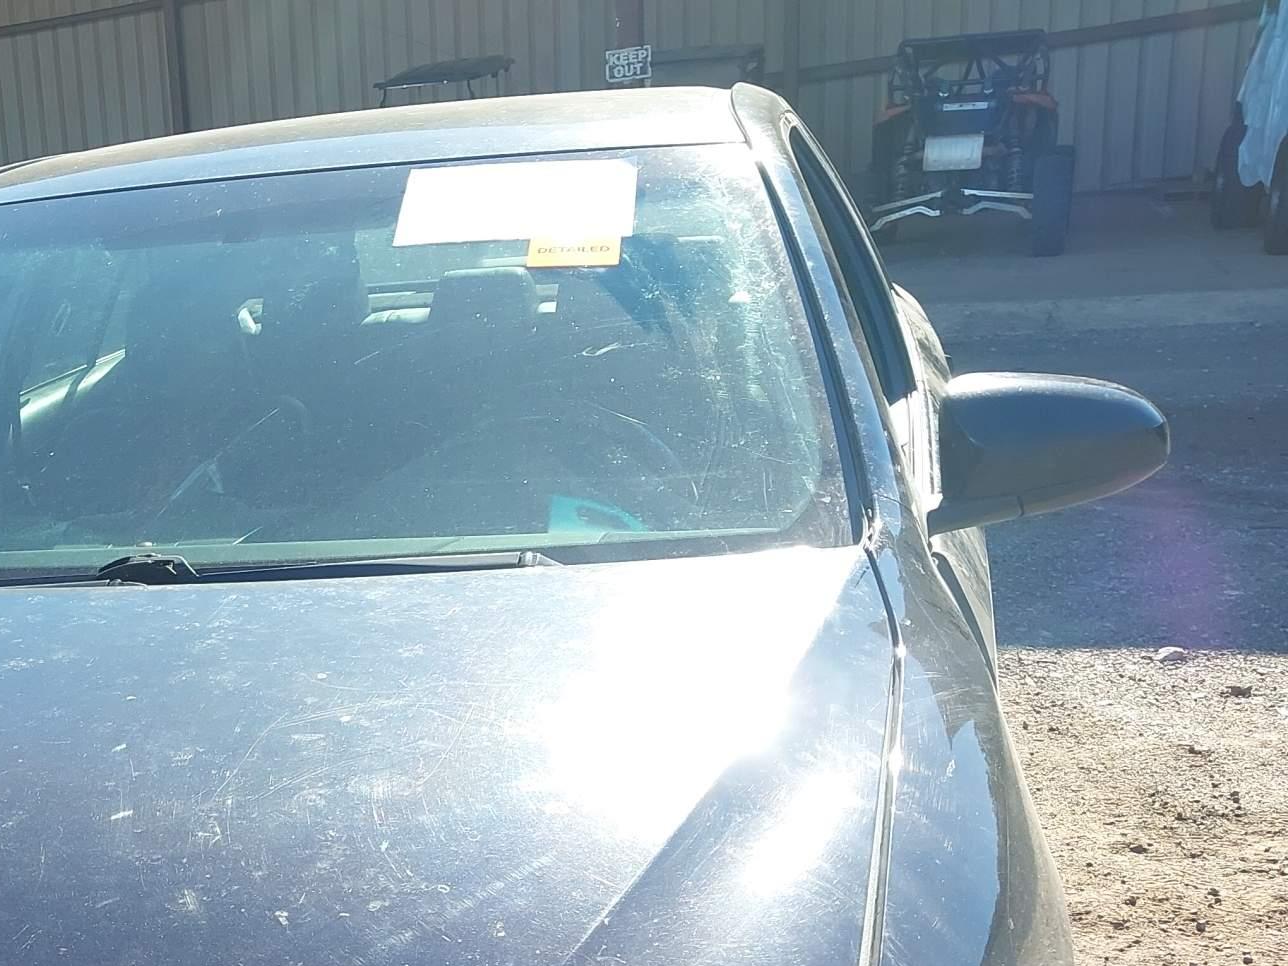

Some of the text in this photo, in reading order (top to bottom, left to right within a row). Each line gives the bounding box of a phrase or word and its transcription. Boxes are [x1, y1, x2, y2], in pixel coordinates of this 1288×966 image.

[609, 50, 647, 65] KEEP
[613, 63, 643, 77] OUT
[537, 245, 611, 254] DETAILED
